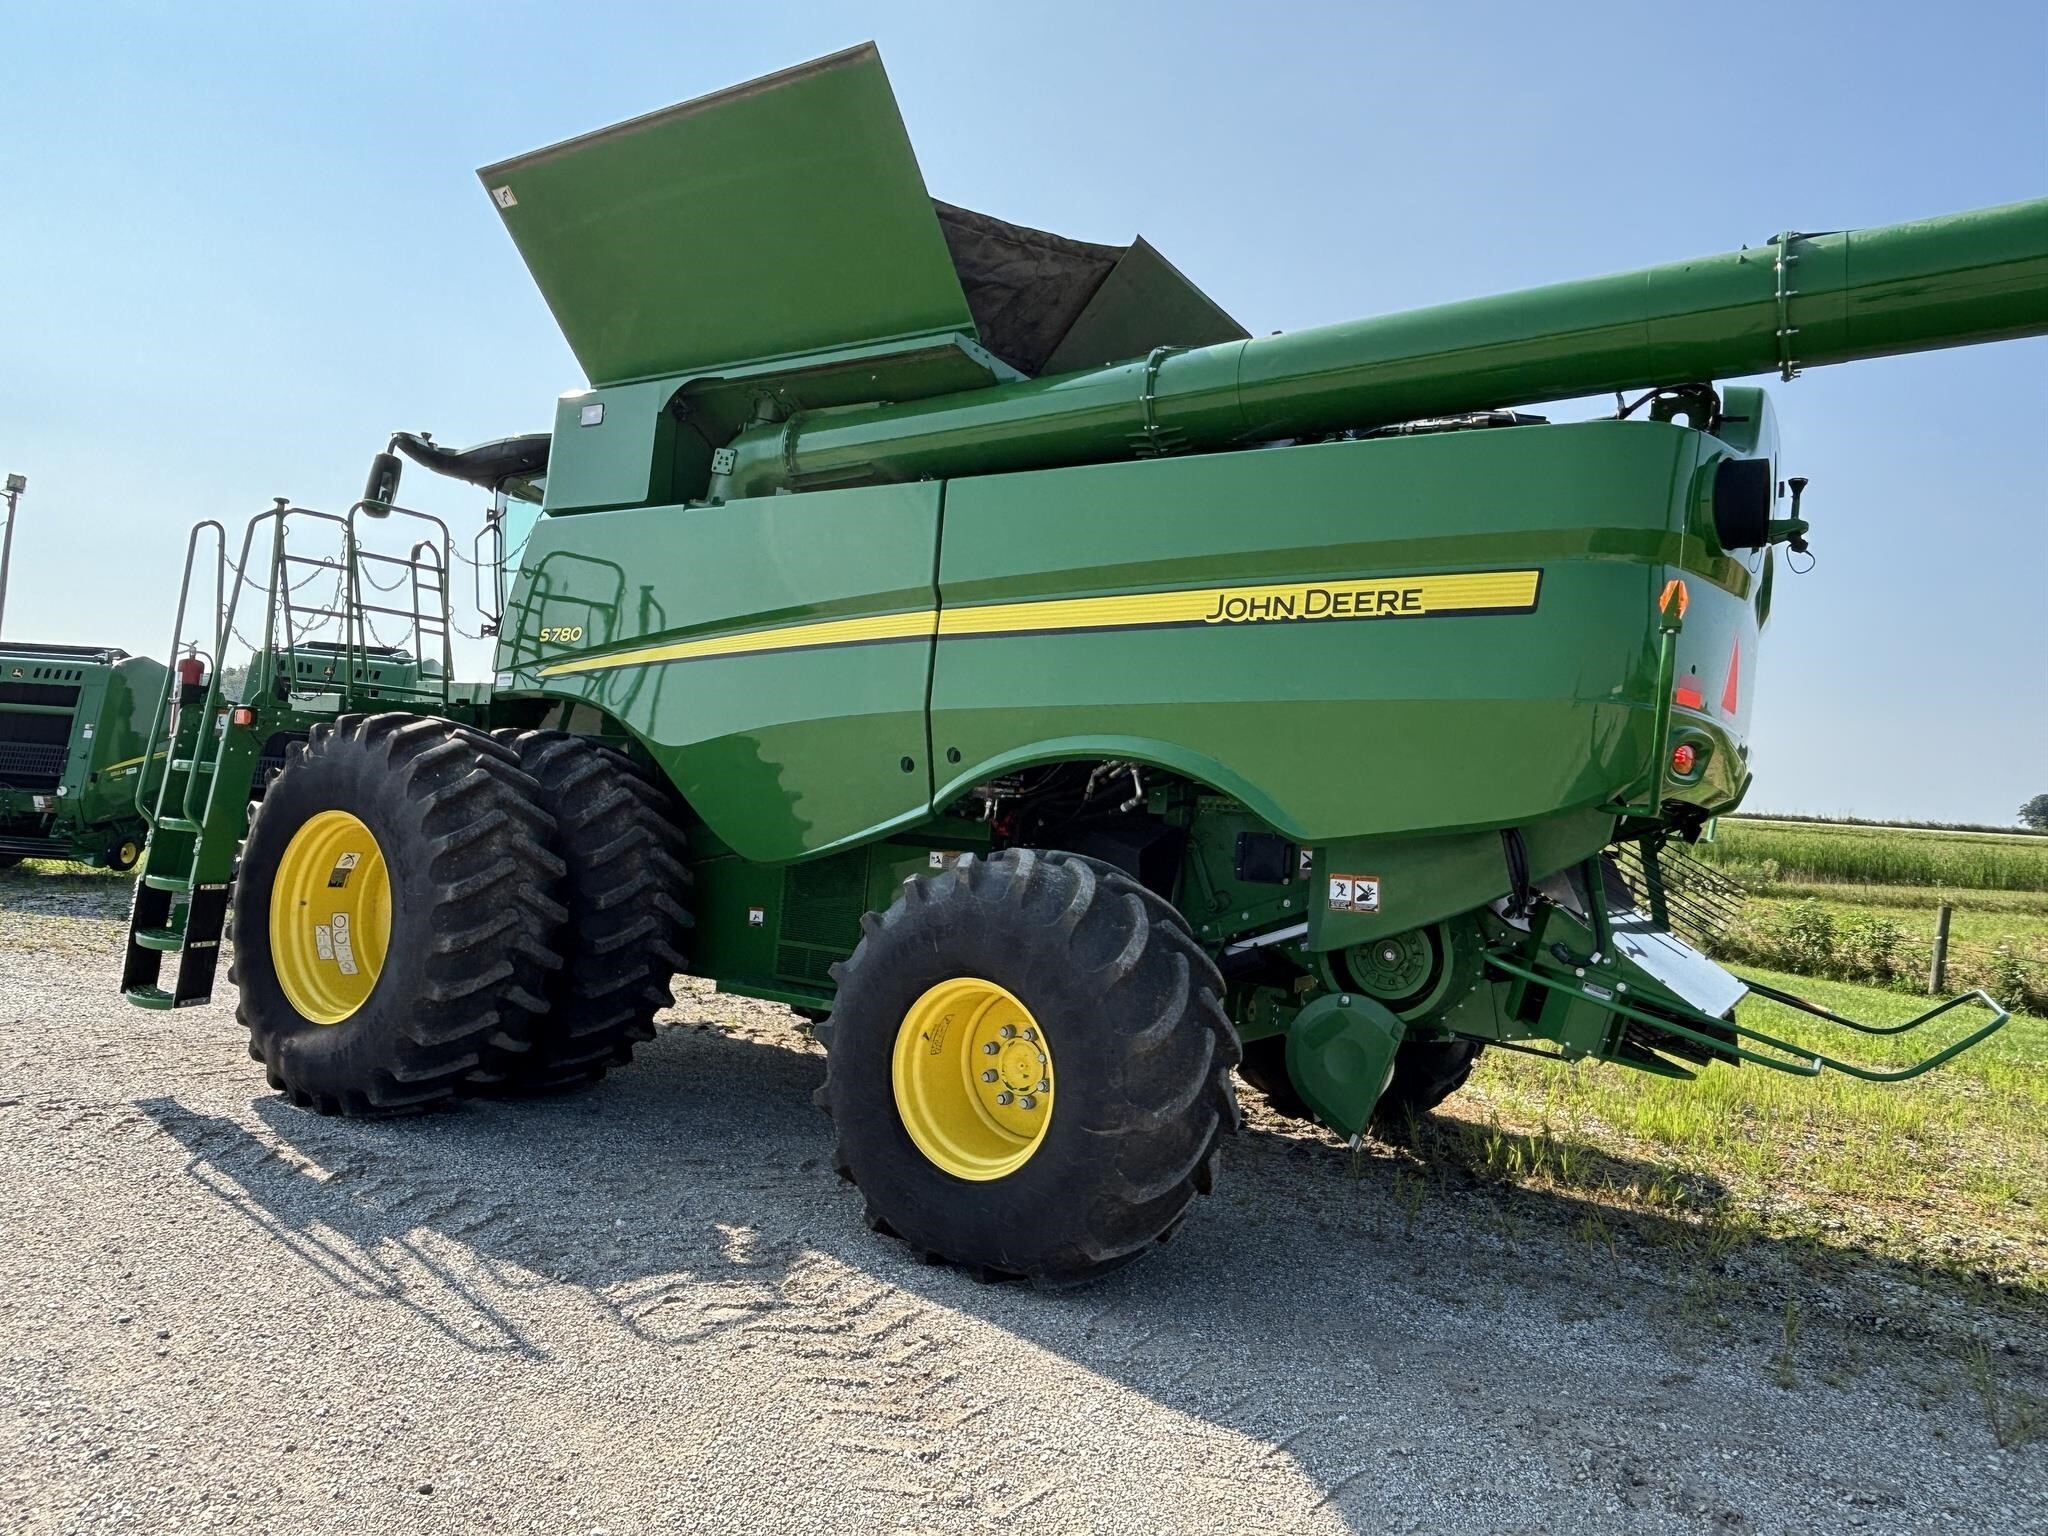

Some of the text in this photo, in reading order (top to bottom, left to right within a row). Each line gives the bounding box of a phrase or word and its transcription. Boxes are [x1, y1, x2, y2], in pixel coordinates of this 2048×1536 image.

[1206, 588, 1423, 620] JOHN DEERE
[539, 626, 583, 642] S780
